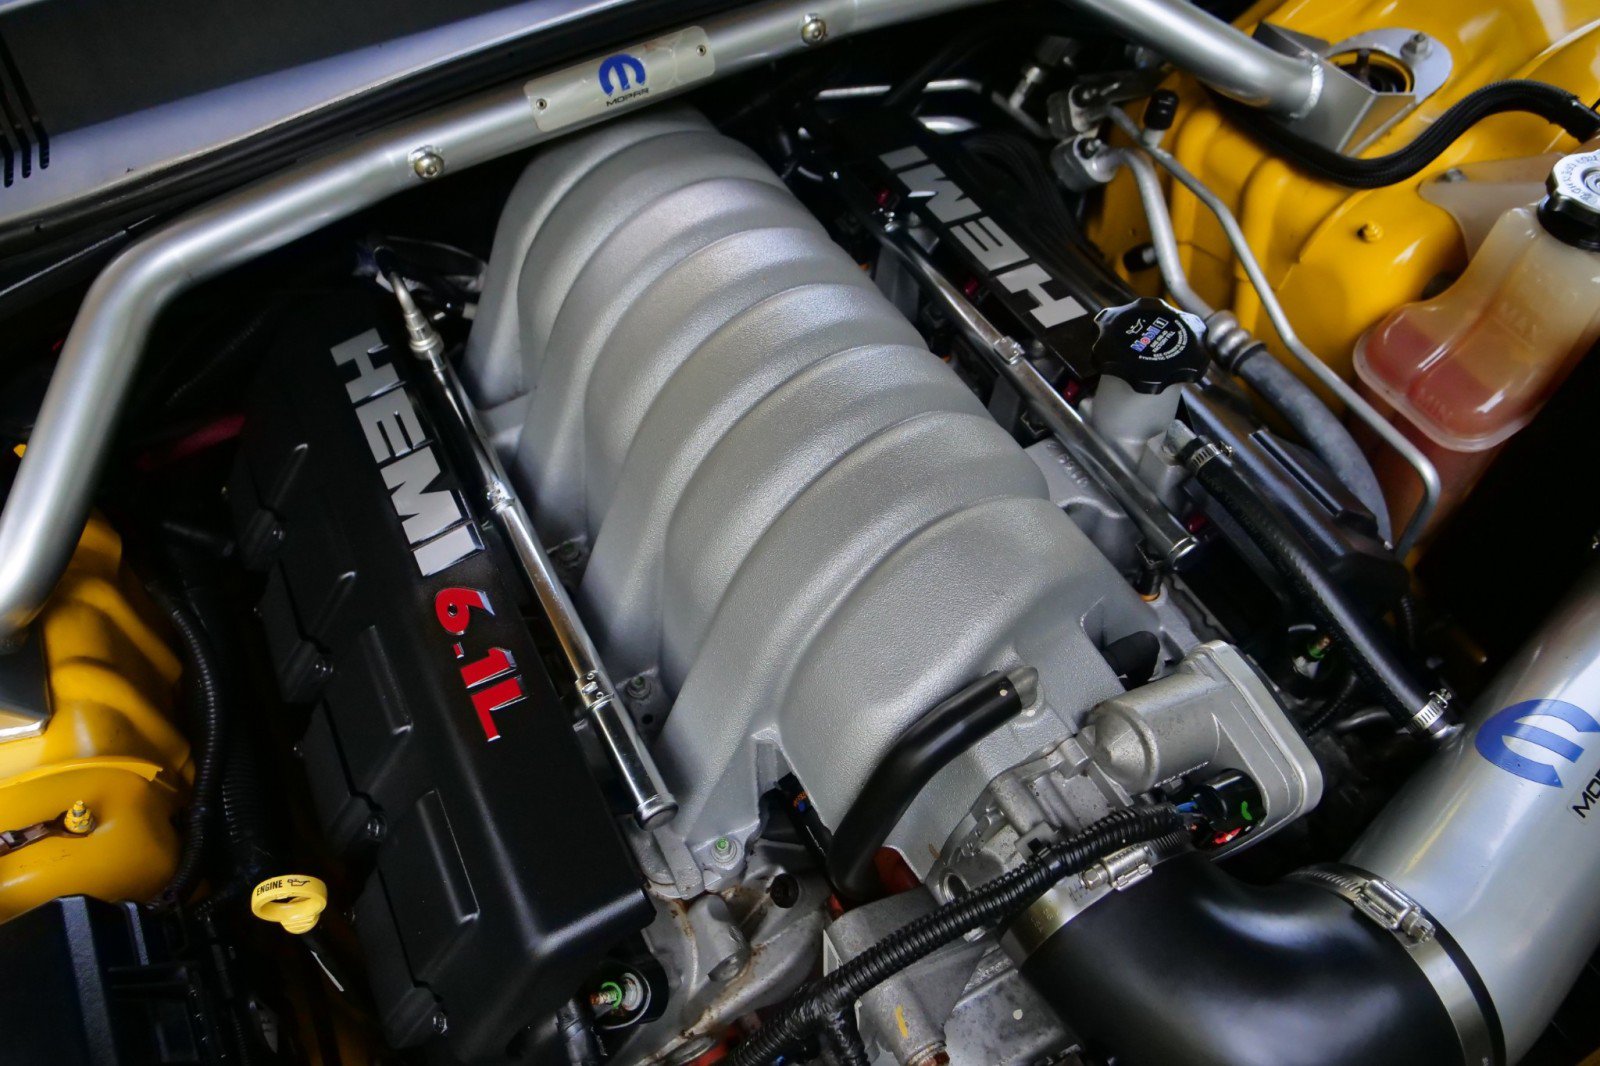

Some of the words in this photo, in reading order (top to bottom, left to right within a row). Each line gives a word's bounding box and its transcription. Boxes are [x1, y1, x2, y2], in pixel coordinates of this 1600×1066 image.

[606, 87, 649, 107] MOPAR
[878, 145, 1089, 329] HEMI
[1129, 324, 1161, 352] Mobil
[330, 327, 486, 577] HEMI
[435, 587, 528, 742] 6.1L
[1572, 768, 1600, 819] MO
[256, 879, 283, 896] ENGINE
